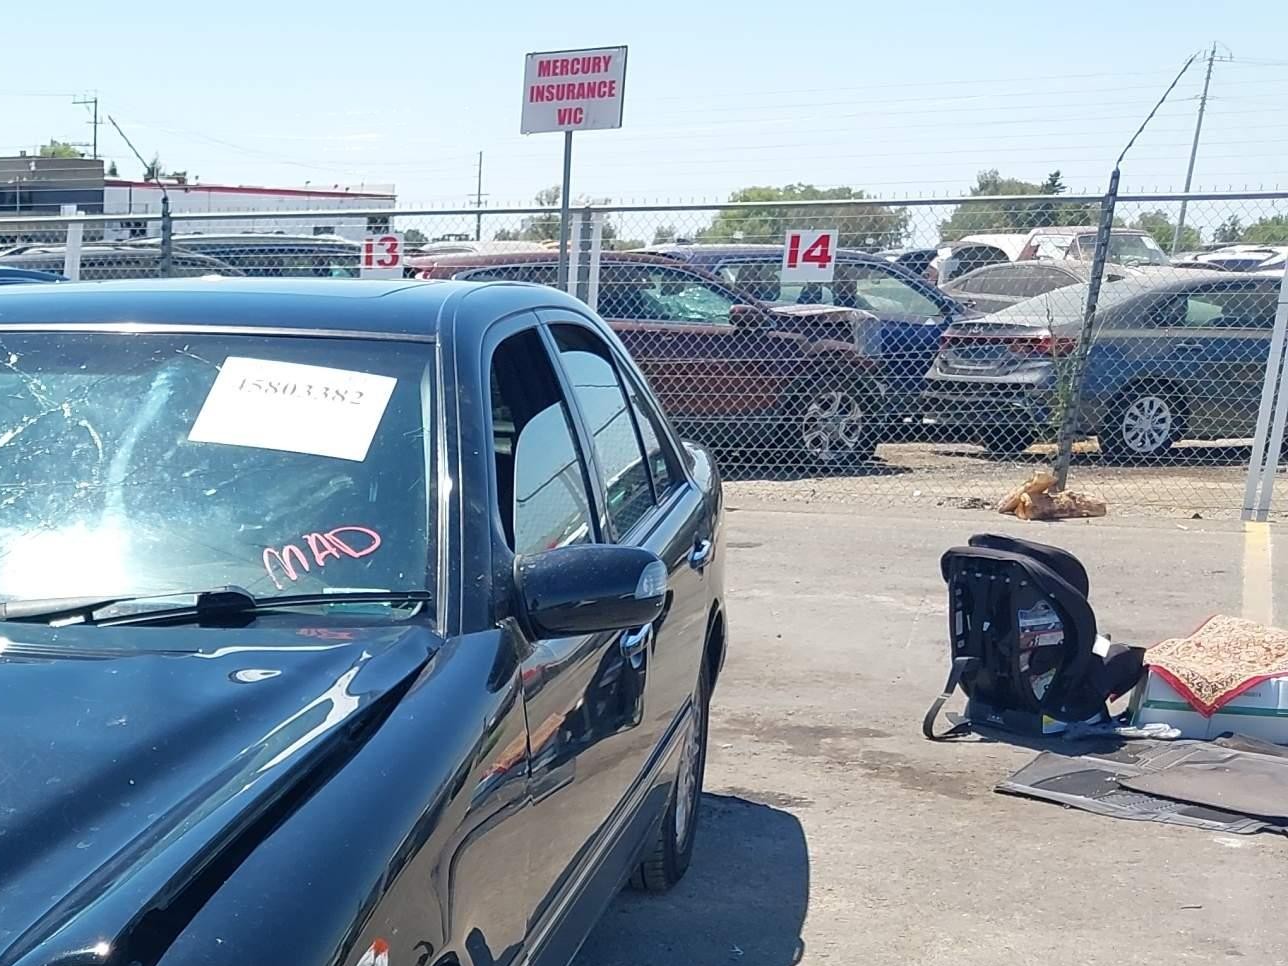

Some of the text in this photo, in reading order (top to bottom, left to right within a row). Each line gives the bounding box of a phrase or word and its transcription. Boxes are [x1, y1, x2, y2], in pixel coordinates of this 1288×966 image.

[537, 55, 612, 78] MERCURY
[529, 80, 616, 103] INSURANCE
[557, 107, 584, 126] VIC
[364, 236, 400, 270] 13
[787, 234, 832, 269] 14
[262, 526, 381, 590] MAD
